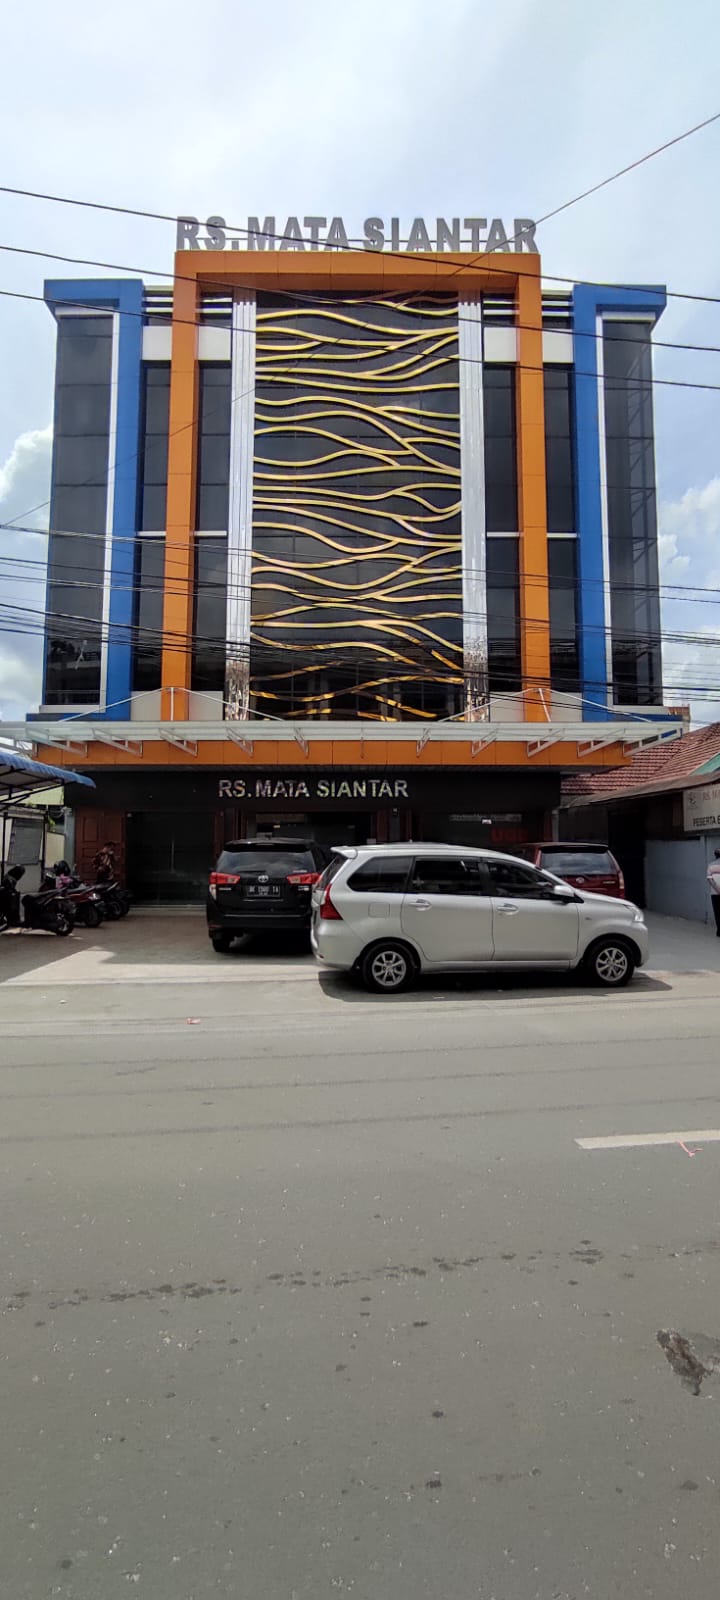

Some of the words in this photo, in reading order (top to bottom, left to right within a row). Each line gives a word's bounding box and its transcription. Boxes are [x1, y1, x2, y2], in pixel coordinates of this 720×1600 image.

[176, 216, 240, 251] RS.
[249, 216, 351, 252] MATA
[363, 217, 540, 253] SIANTAR
[218, 779, 252, 798] RS.
[255, 779, 310, 798] MATA
[316, 779, 409, 798] SIANTAR
